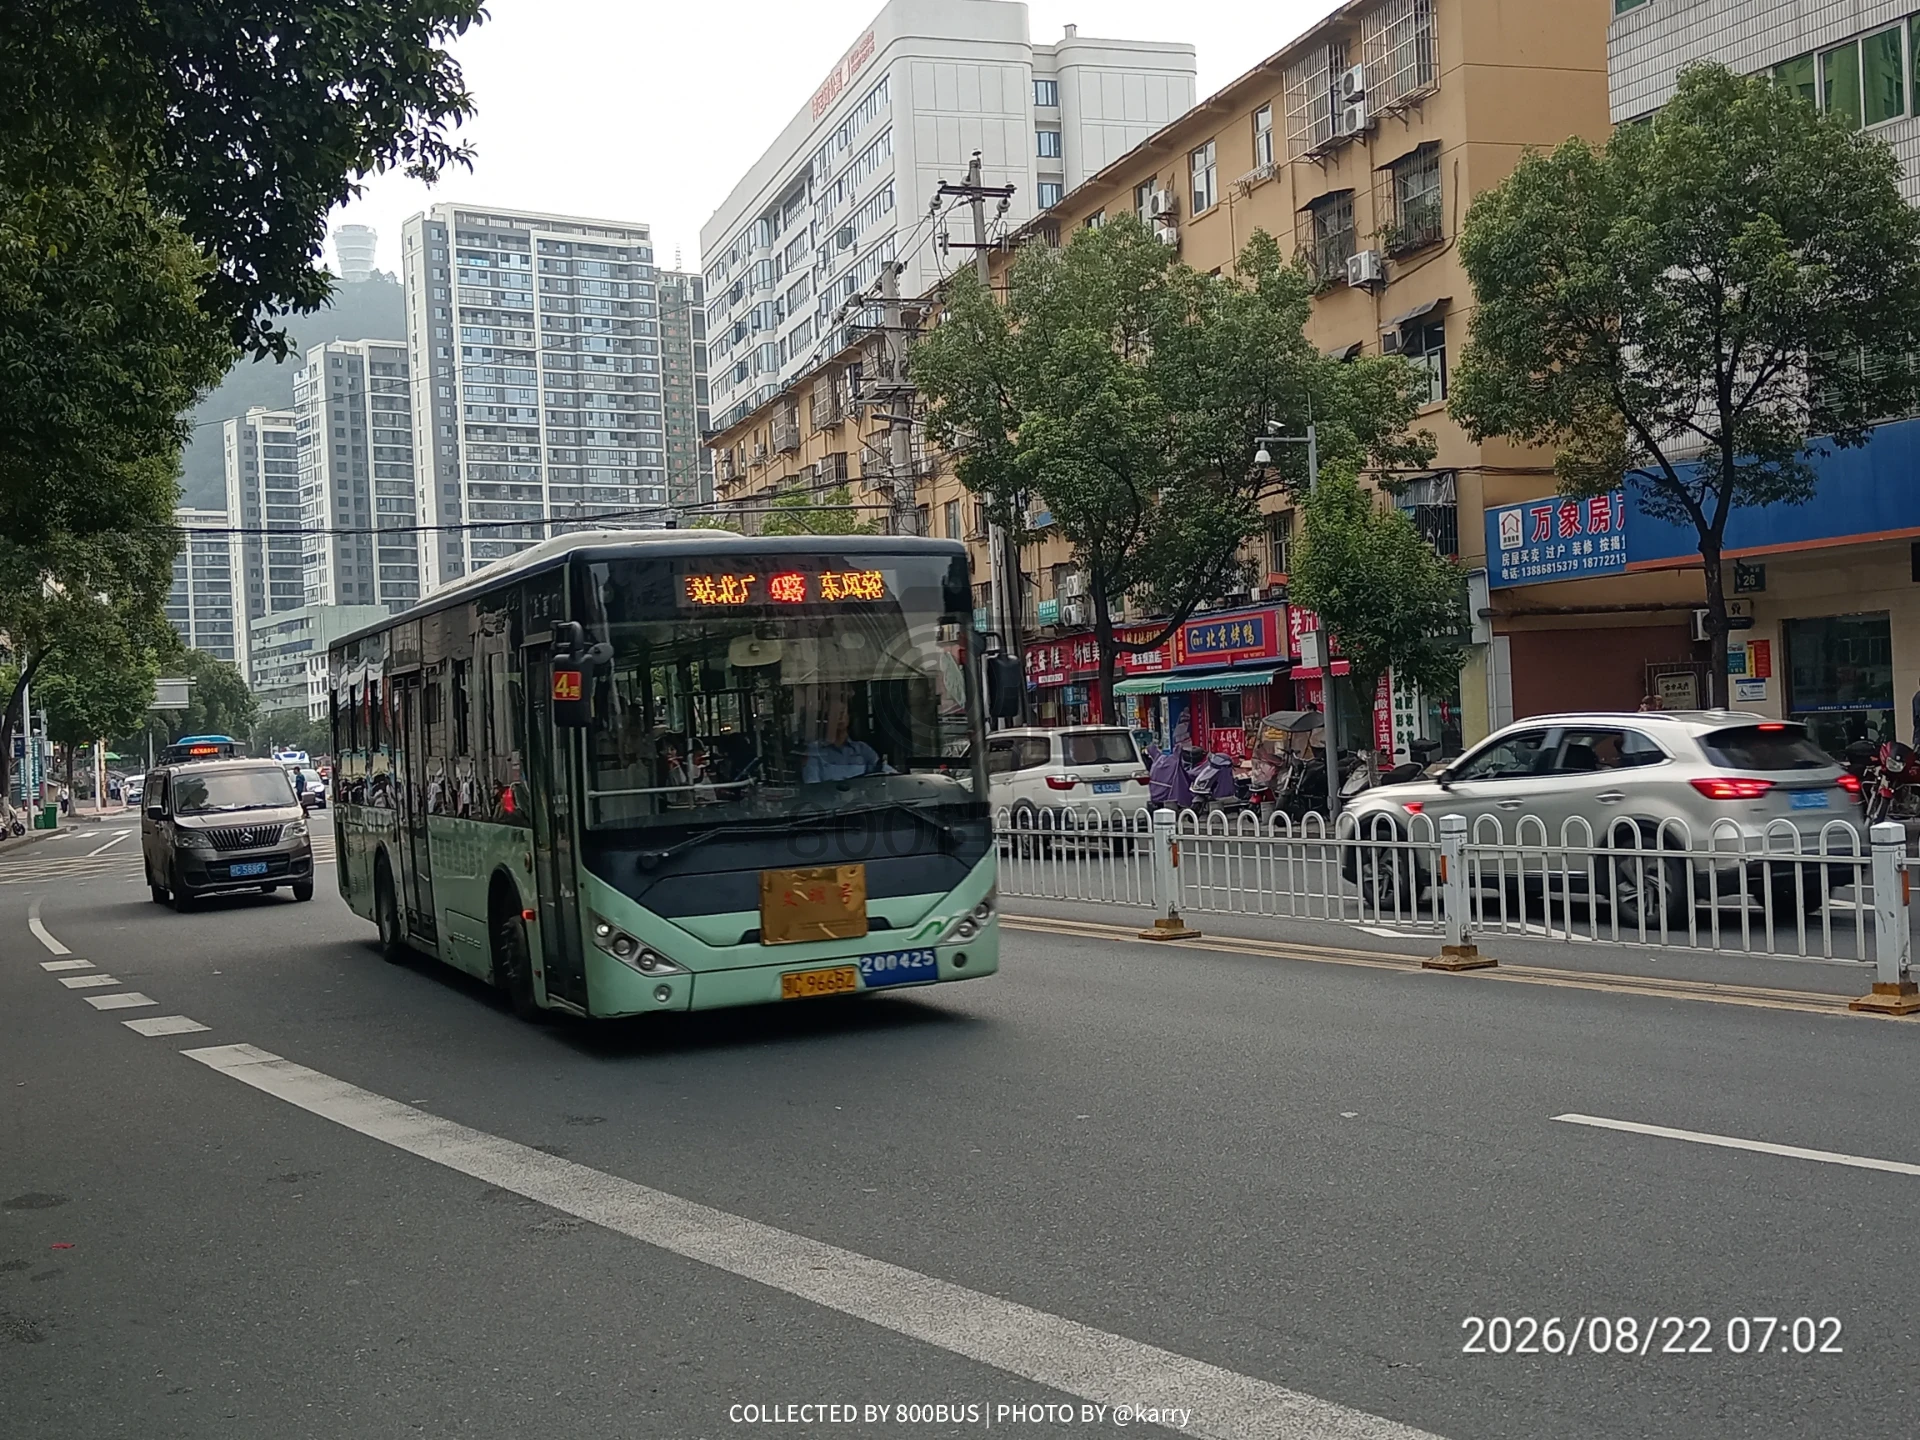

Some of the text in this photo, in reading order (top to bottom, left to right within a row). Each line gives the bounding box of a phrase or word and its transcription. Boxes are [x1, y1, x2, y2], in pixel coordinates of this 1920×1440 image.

[1501, 547, 1540, 567] 房屋买卖
[1545, 543, 1566, 560] 过户
[1572, 539, 1594, 556] 装修
[1582, 552, 1627, 569] 18772213
[1743, 574, 1756, 586] 26
[1206, 620, 1255, 649] 北京烤鸭
[861, 950, 935, 973] 200425
